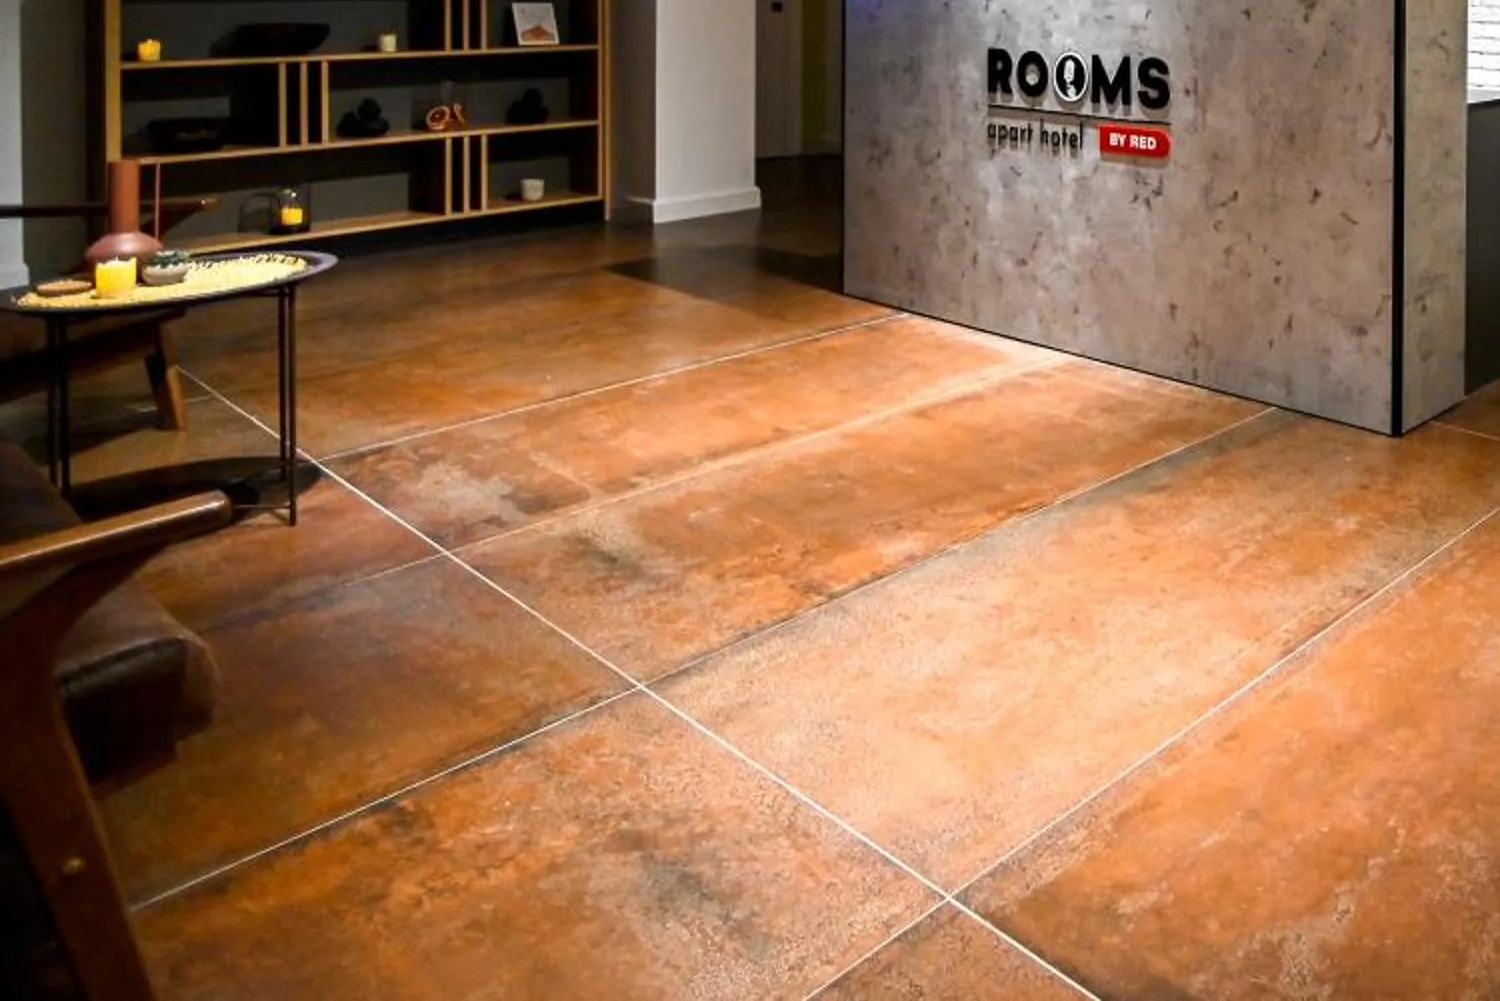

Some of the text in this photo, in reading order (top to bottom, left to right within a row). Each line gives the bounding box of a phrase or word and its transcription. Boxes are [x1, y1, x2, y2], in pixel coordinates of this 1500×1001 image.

[987, 47, 1171, 110] ROOMS
[987, 118, 1084, 150] apart hotel
[1109, 132, 1157, 150] BY RED
